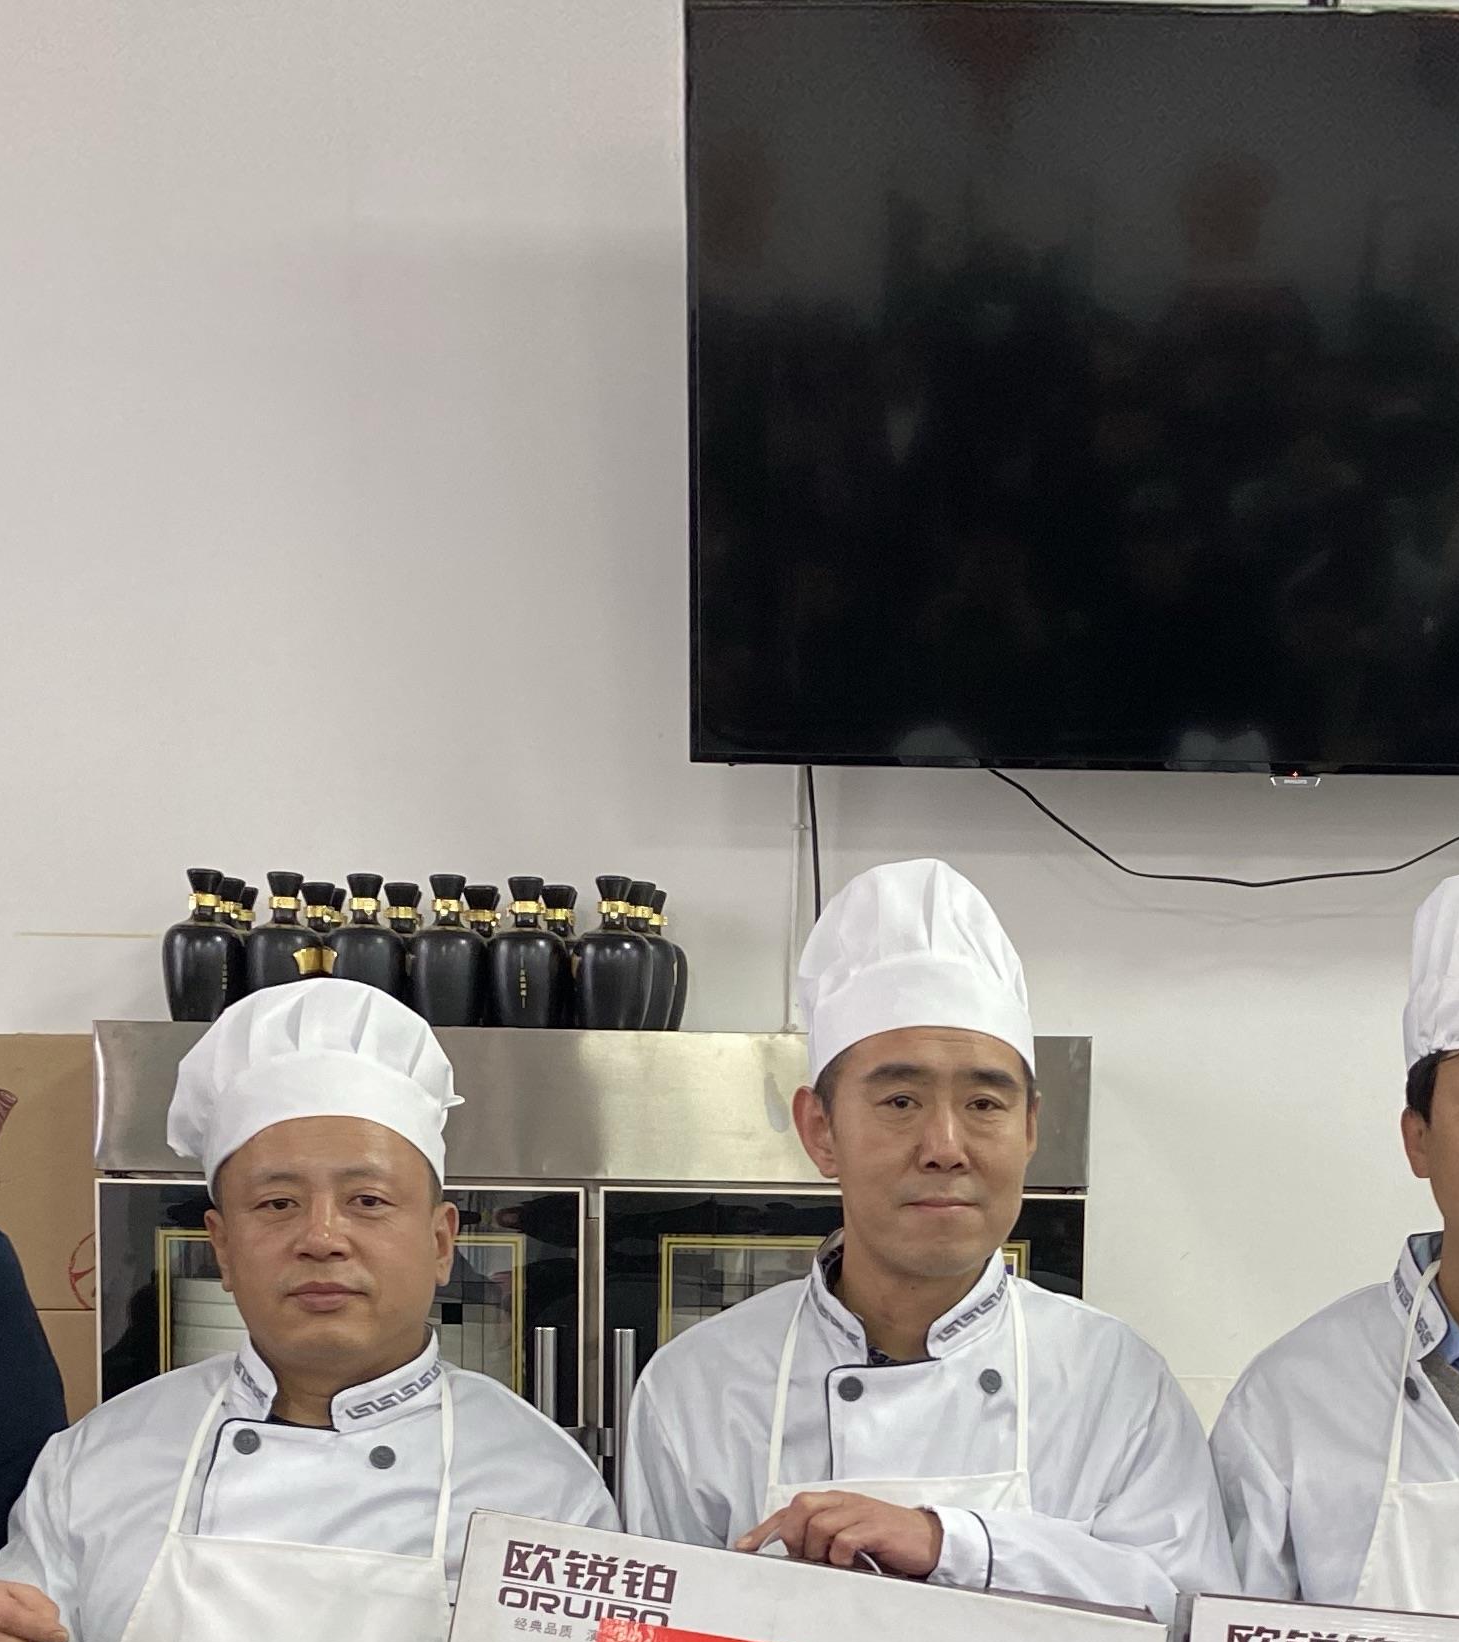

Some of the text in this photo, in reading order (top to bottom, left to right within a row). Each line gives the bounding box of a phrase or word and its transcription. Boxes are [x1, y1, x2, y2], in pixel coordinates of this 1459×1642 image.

[503, 1540, 678, 1604] 欧锐铂
[513, 1616, 573, 1639] 经典品质
